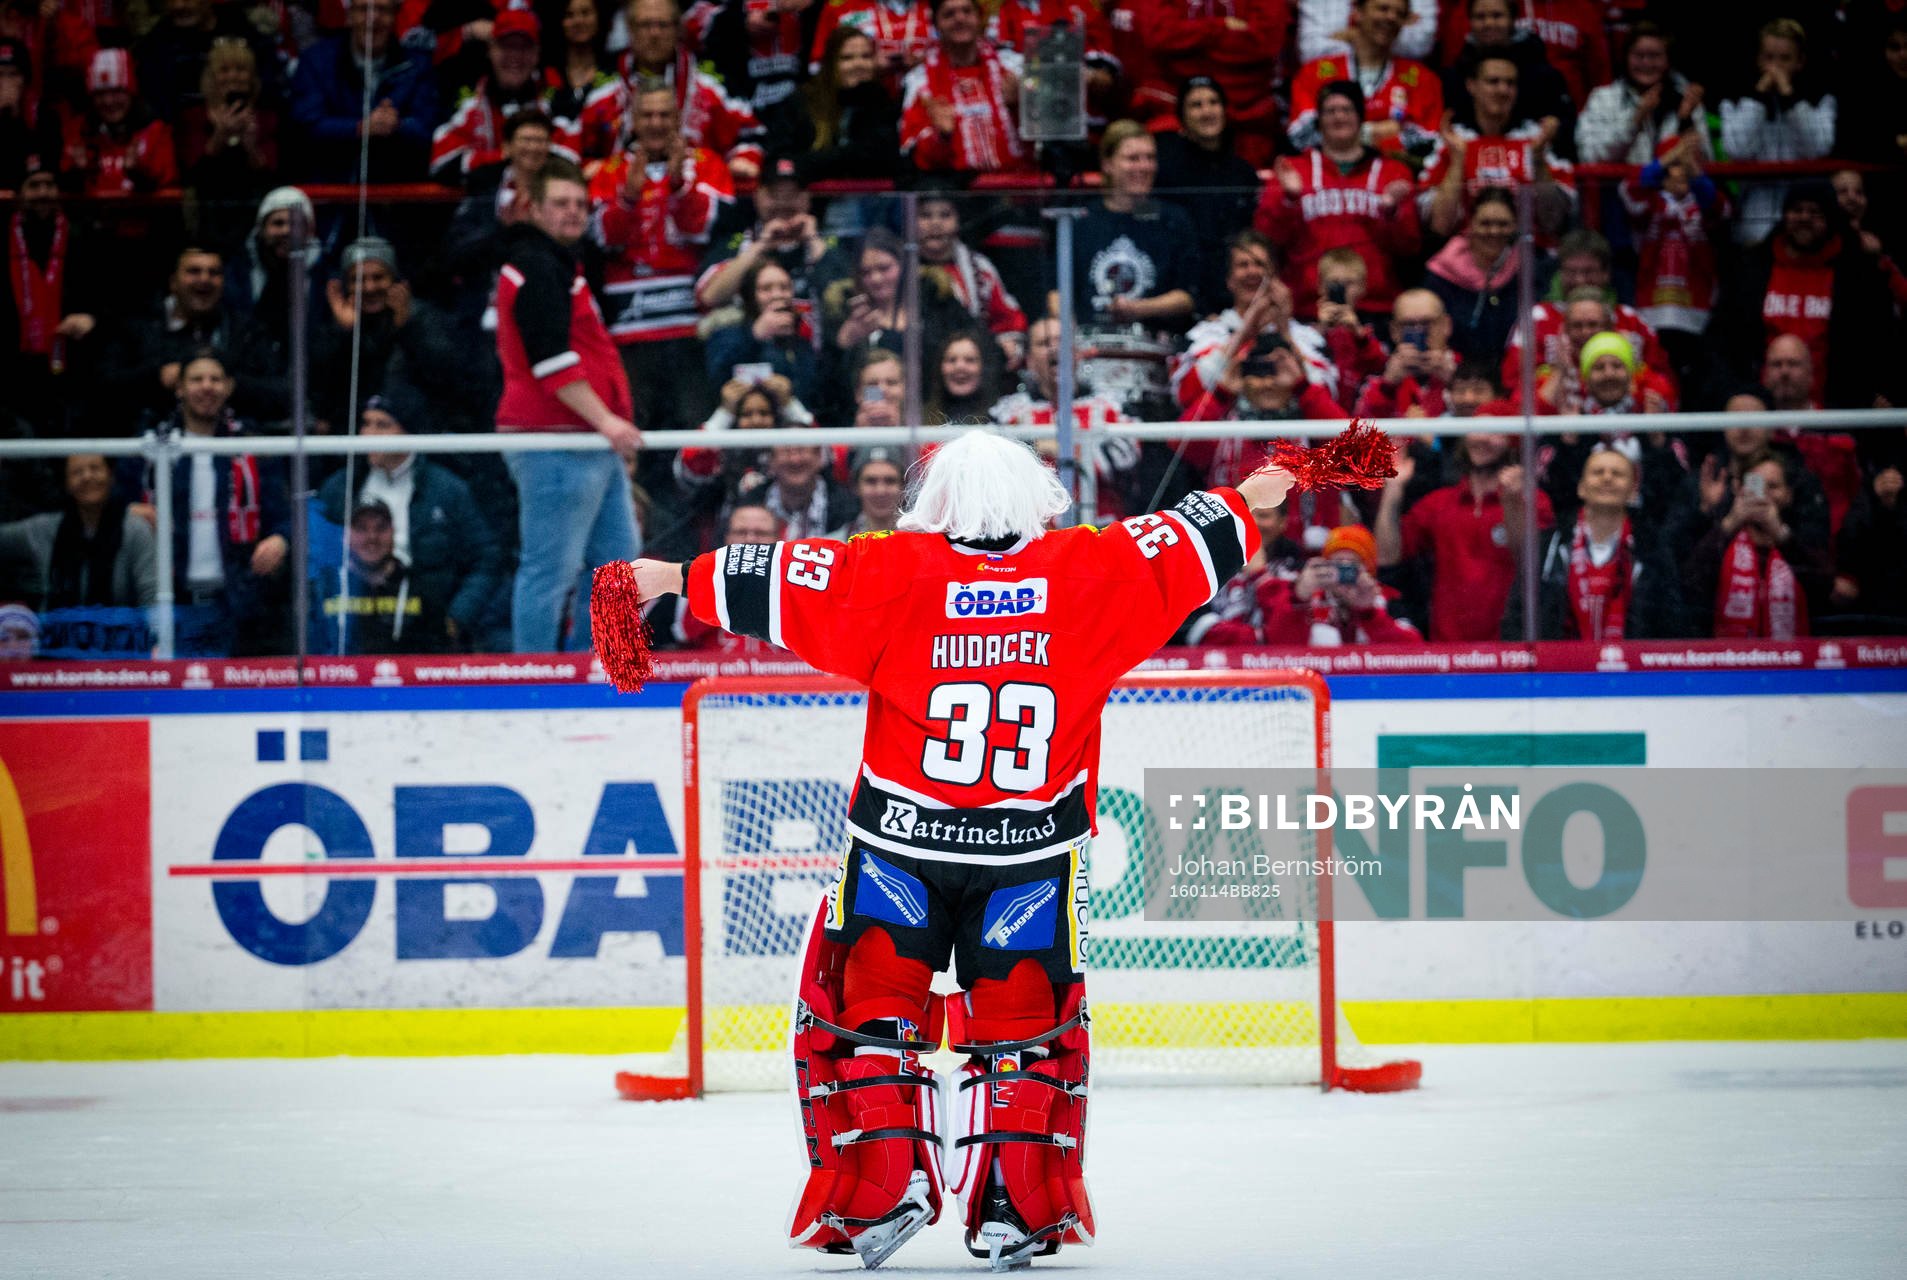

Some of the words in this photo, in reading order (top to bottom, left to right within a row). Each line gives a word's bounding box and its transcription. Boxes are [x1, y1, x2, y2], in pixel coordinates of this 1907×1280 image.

[1191, 513, 1210, 527] DET
[1195, 501, 1219, 522] SOM
[743, 544, 757, 561] SOM
[1121, 513, 1179, 559] 33
[726, 543, 745, 575] ÖREBRO
[786, 543, 835, 591] 33
[955, 585, 1035, 616] ÖBAB
[931, 631, 1051, 669] HUDACEK
[1334, 652, 1361, 669] och
[1453, 650, 1498, 667] sedan
[921, 681, 1056, 792] 33
[883, 802, 1056, 845] Katrinelund
[867, 867, 919, 925] ByggTema
[998, 886, 1057, 941] ByggTema
